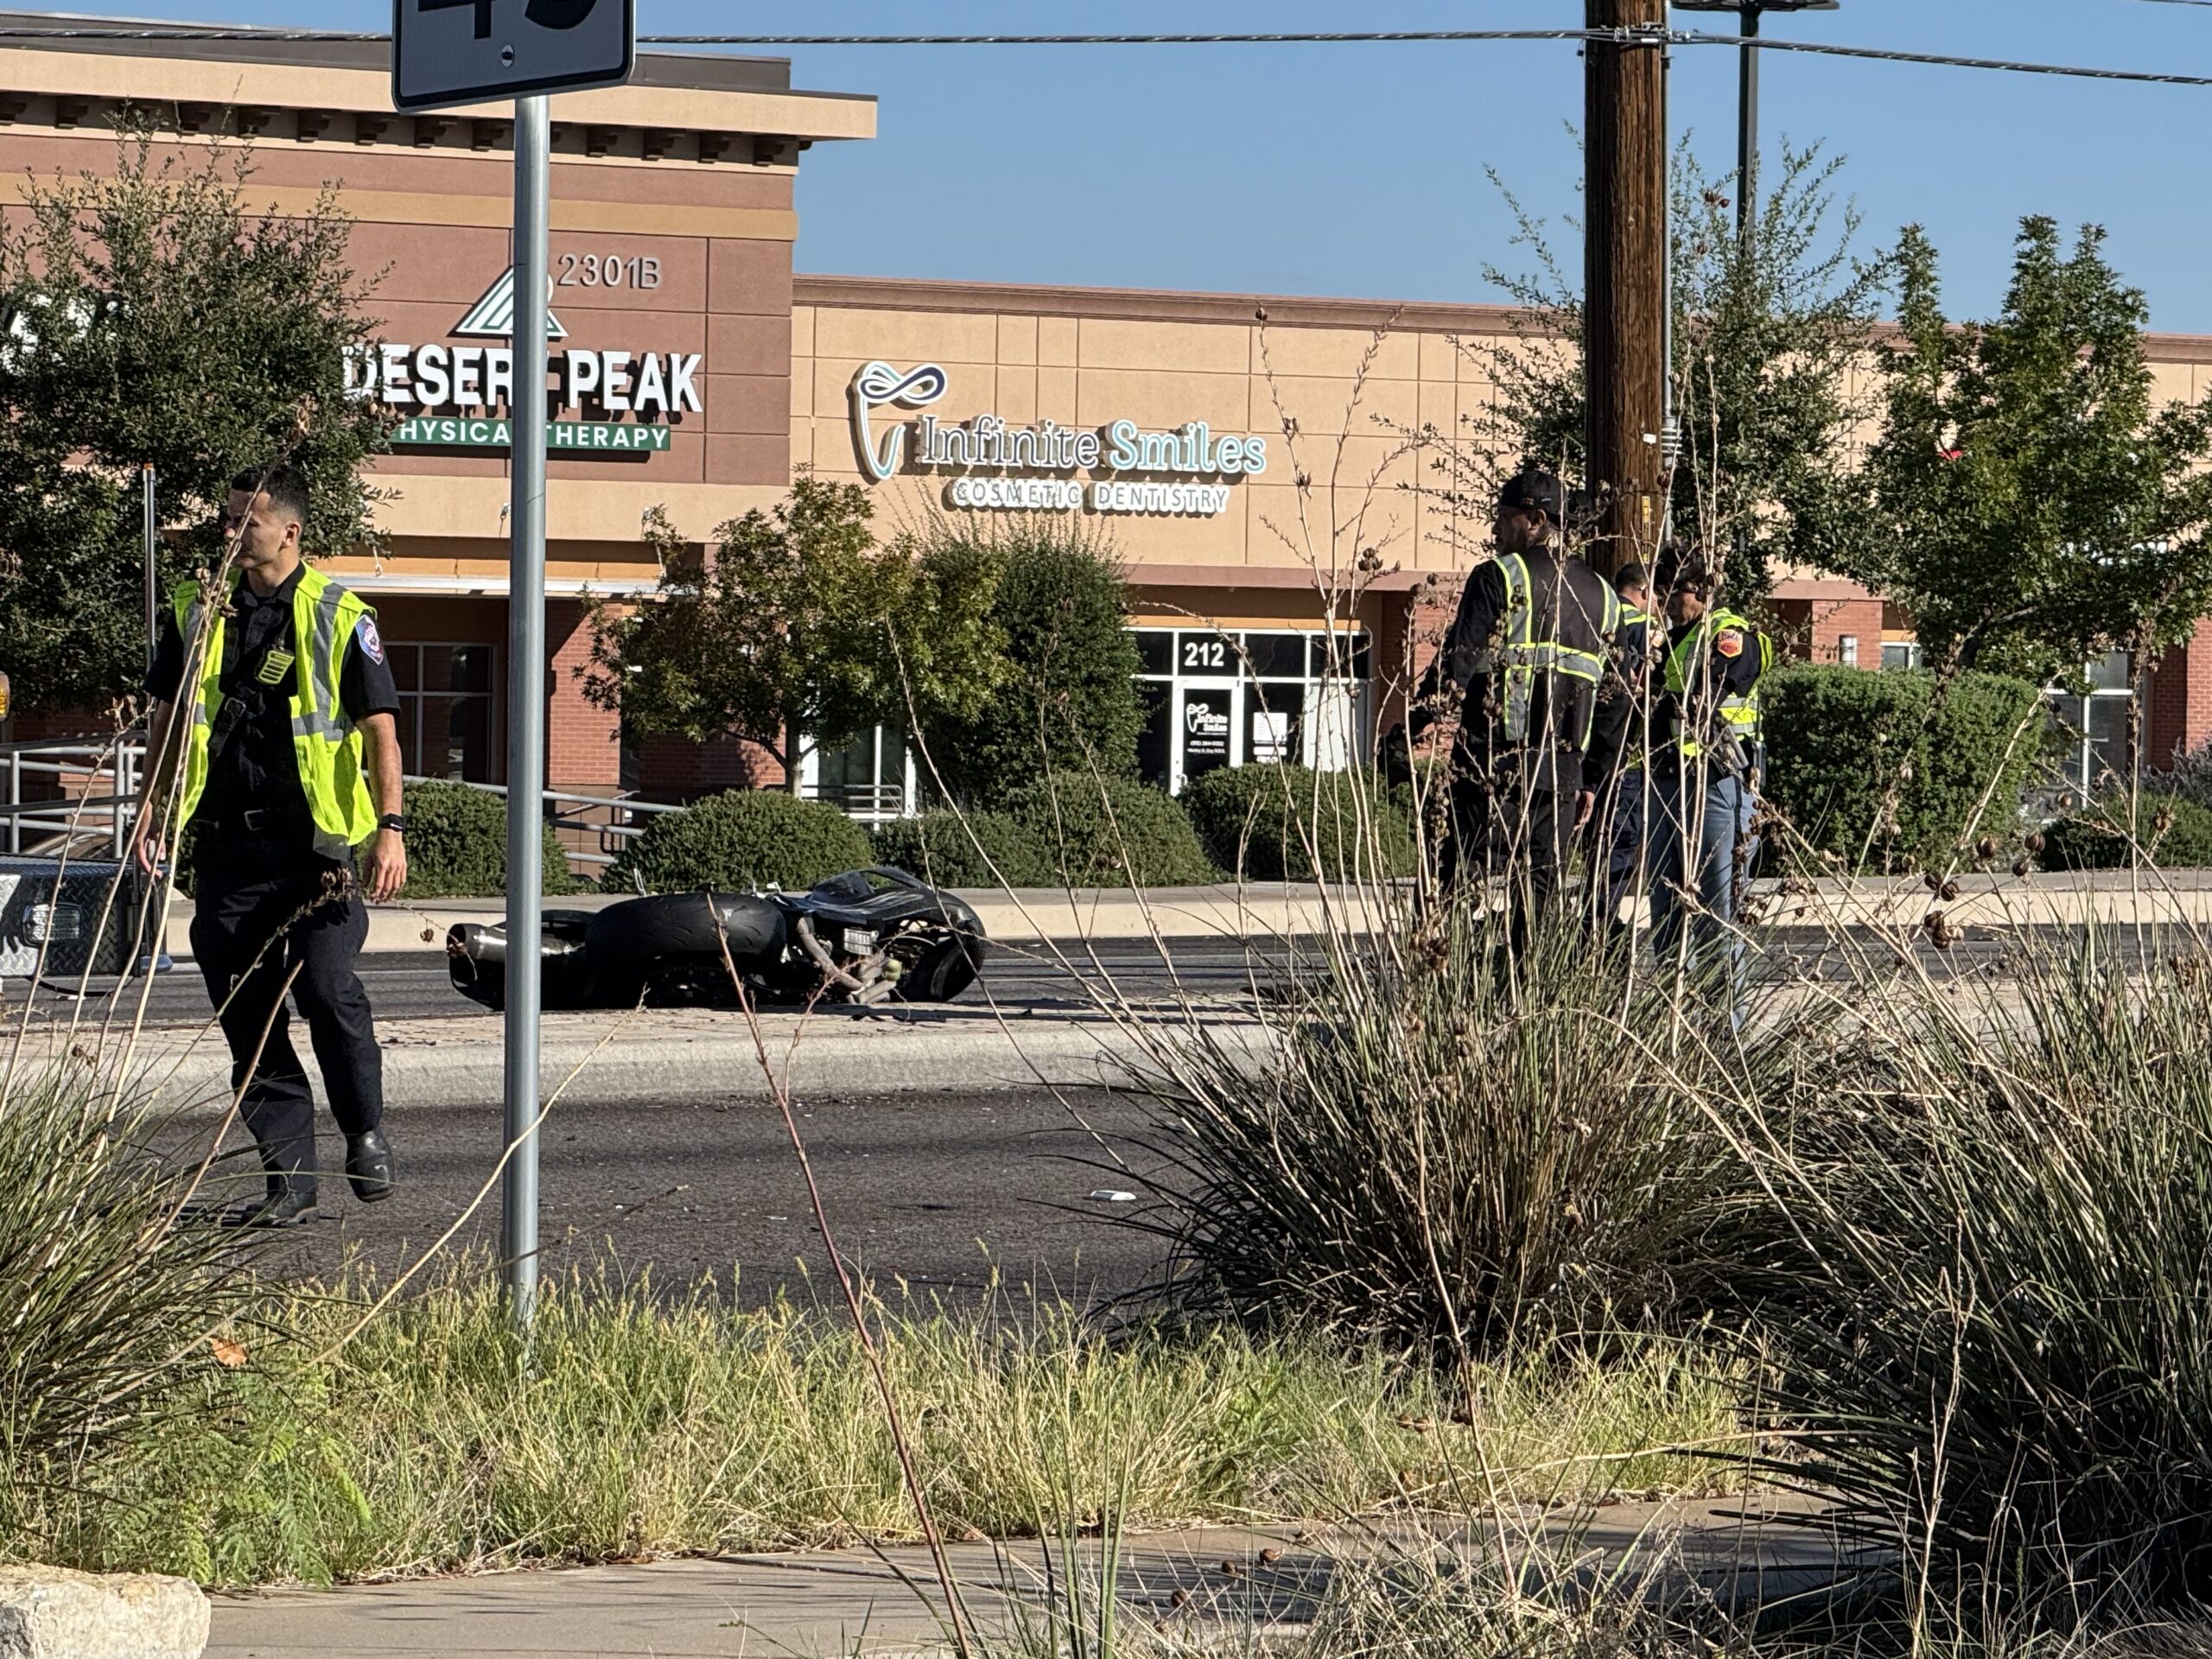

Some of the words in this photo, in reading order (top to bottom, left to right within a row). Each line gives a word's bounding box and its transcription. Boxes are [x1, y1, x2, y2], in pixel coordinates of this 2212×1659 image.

[558, 253, 662, 289] 2301B
[340, 344, 550, 406] DESER
[567, 350, 703, 412] PEAK
[394, 419, 512, 444] HYSICA
[923, 415, 1099, 467] Infinite
[1109, 419, 1266, 474] Smiles
[955, 480, 1082, 508] COSMETIC
[1096, 483, 1229, 512] DENTISTRY
[1185, 642, 1224, 666] 212
